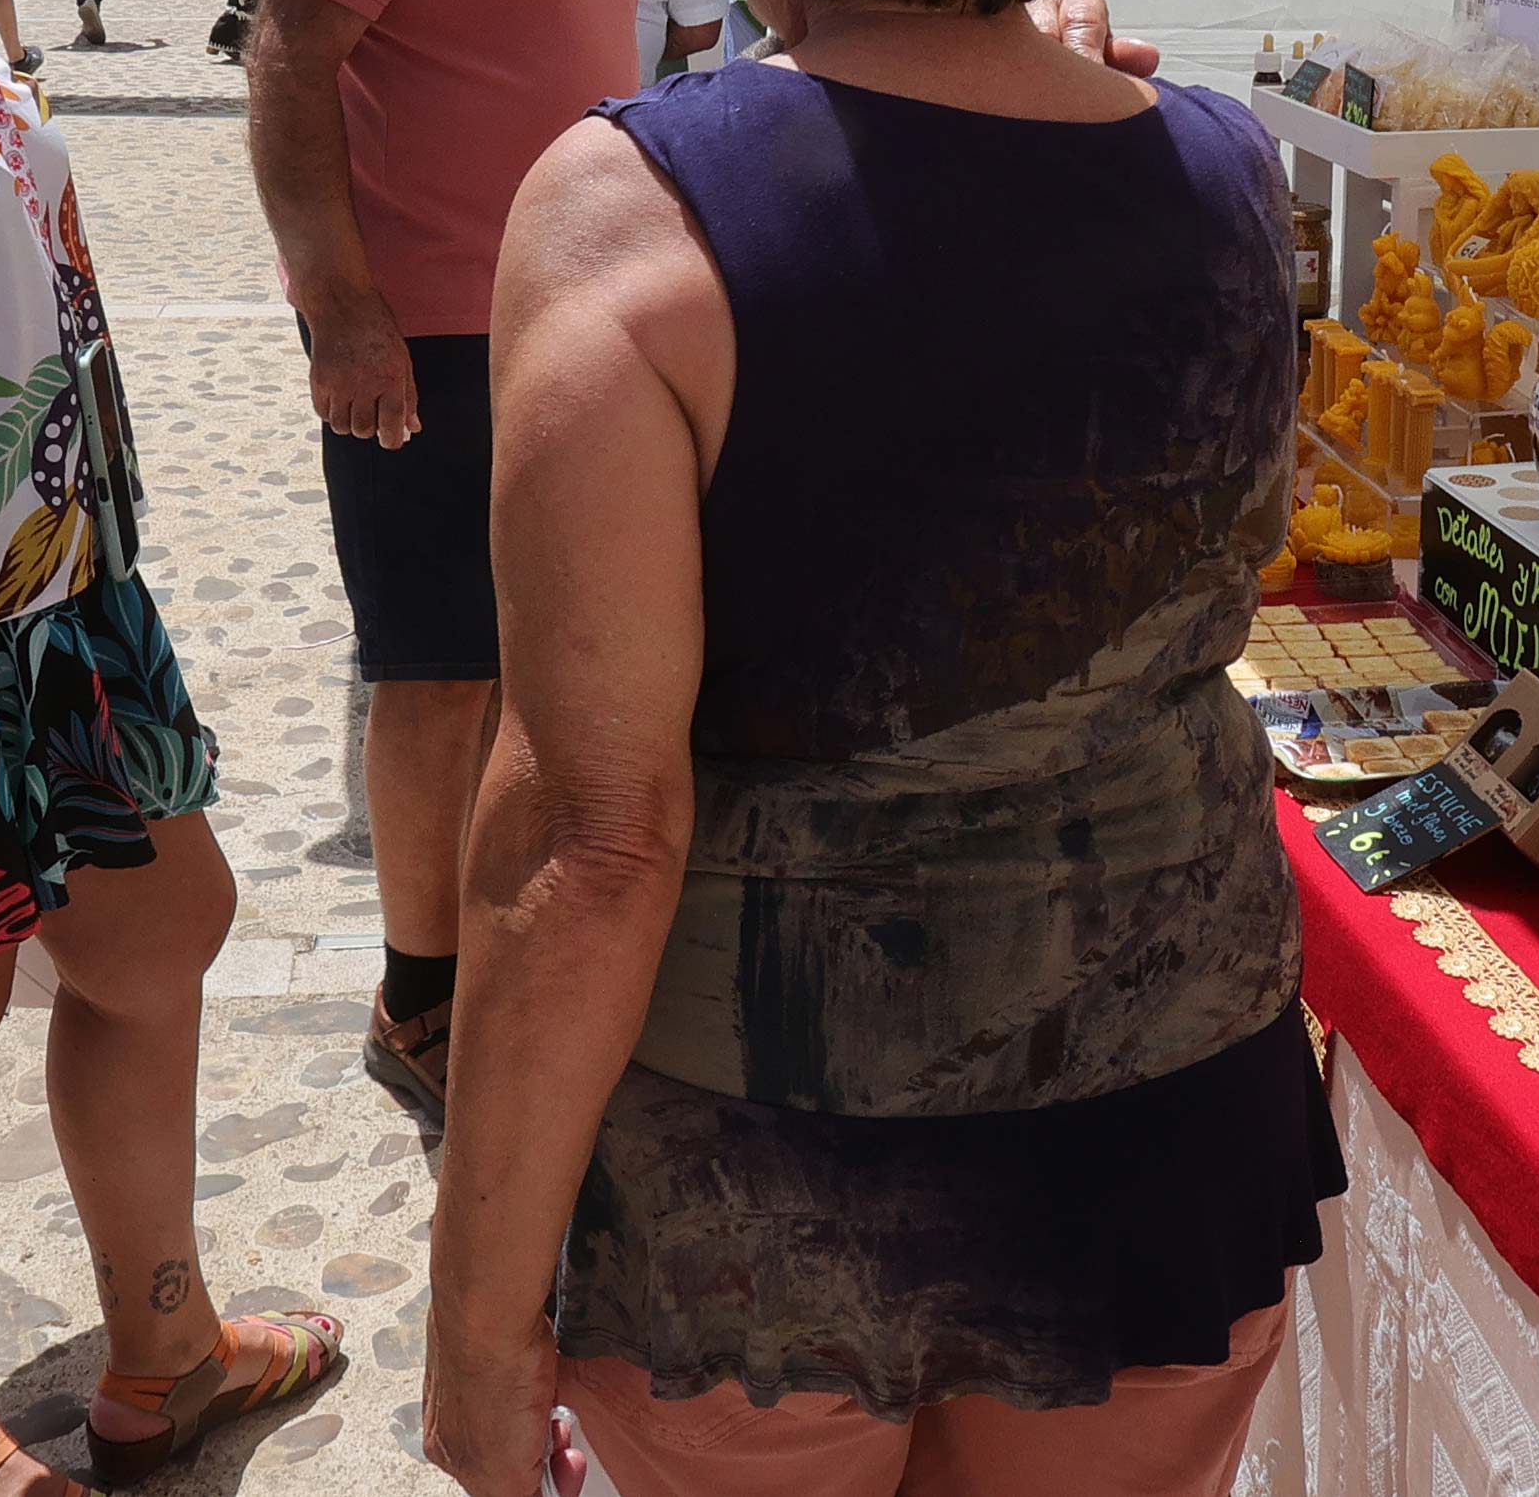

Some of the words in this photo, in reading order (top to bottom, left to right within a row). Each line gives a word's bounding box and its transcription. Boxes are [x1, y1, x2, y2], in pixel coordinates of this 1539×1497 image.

[1437, 506, 1504, 574] Detalles
[1435, 576, 1458, 611] con
[1415, 772, 1484, 836] ESTUCHE
